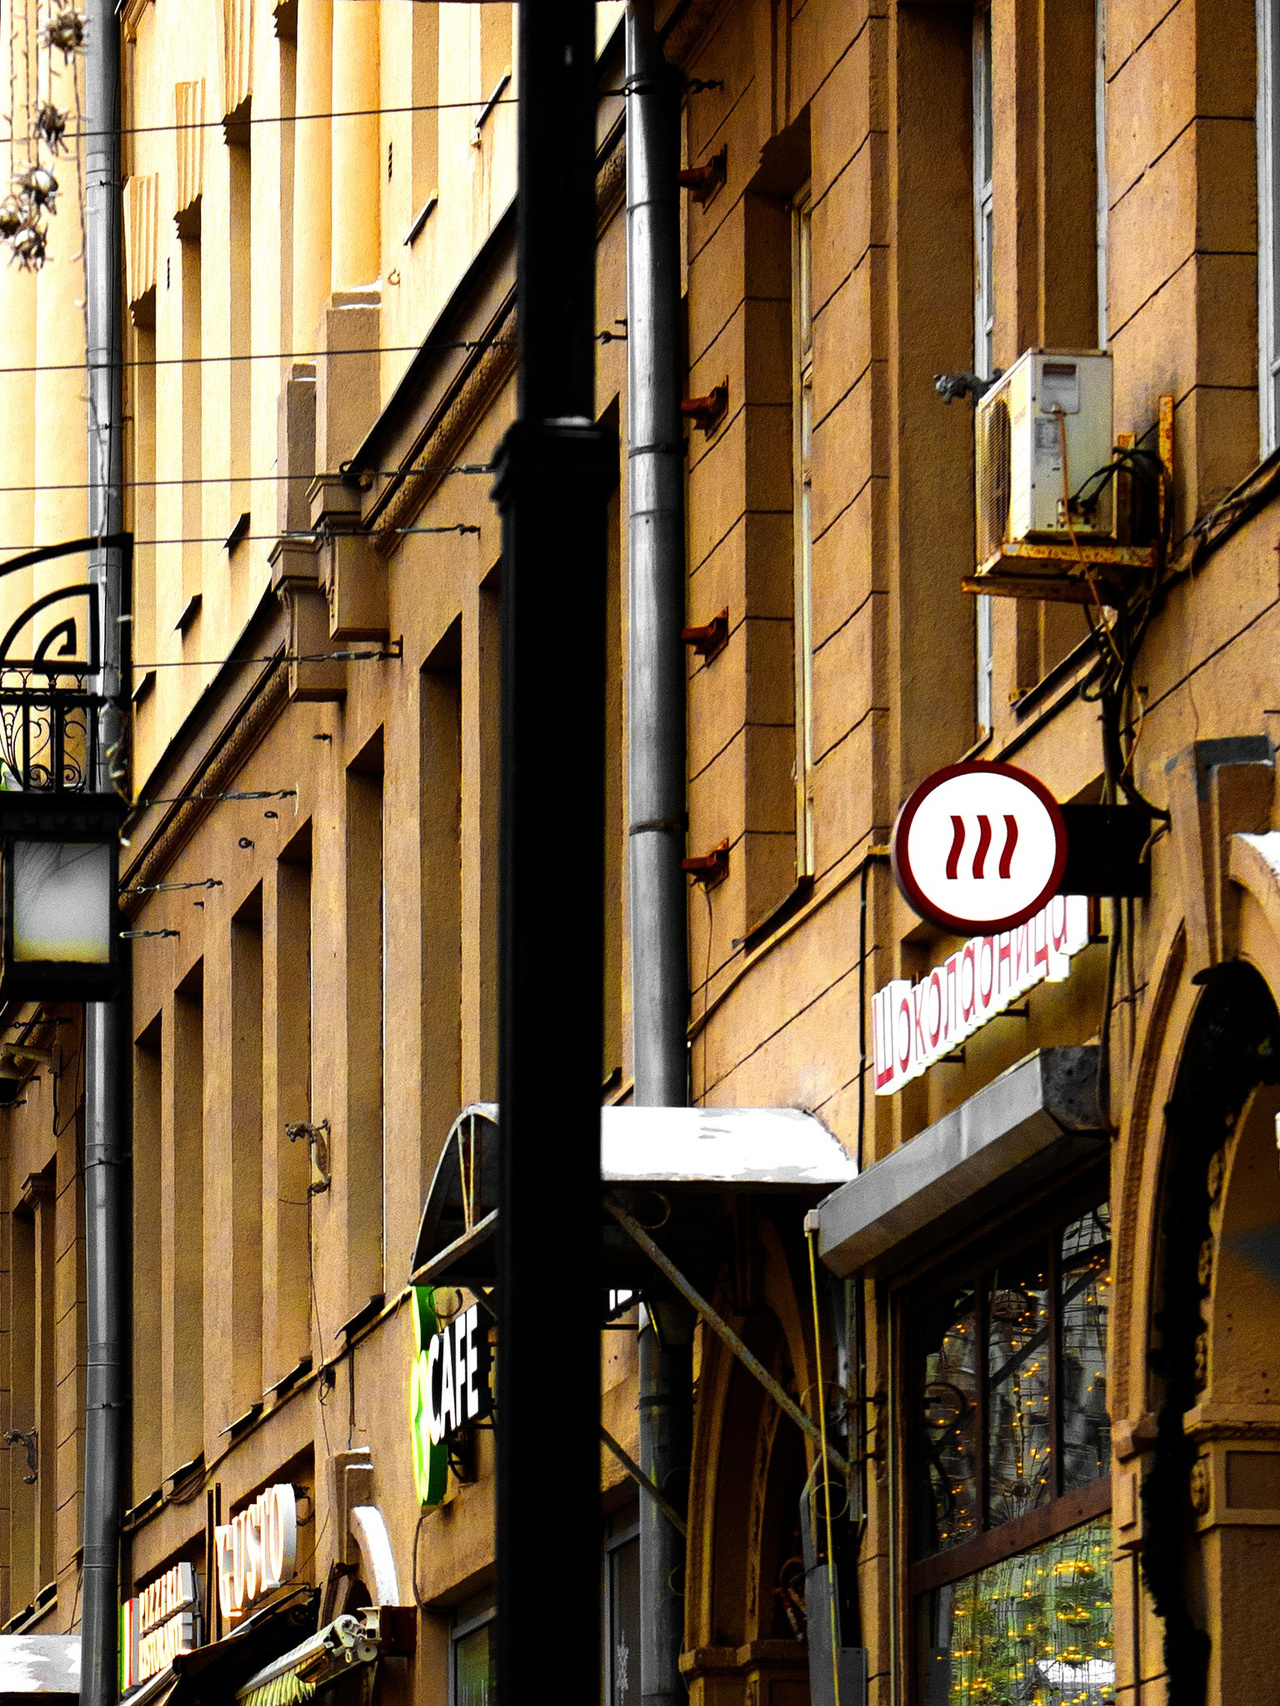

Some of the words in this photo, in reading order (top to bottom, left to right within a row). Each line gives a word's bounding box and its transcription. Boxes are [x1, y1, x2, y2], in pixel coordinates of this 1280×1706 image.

[873, 895, 1072, 1092] Шоколадница
[428, 1303, 480, 1446] CAFE
[138, 1565, 184, 1634] PIZZERIA
[215, 1484, 289, 1618] GUSTO
